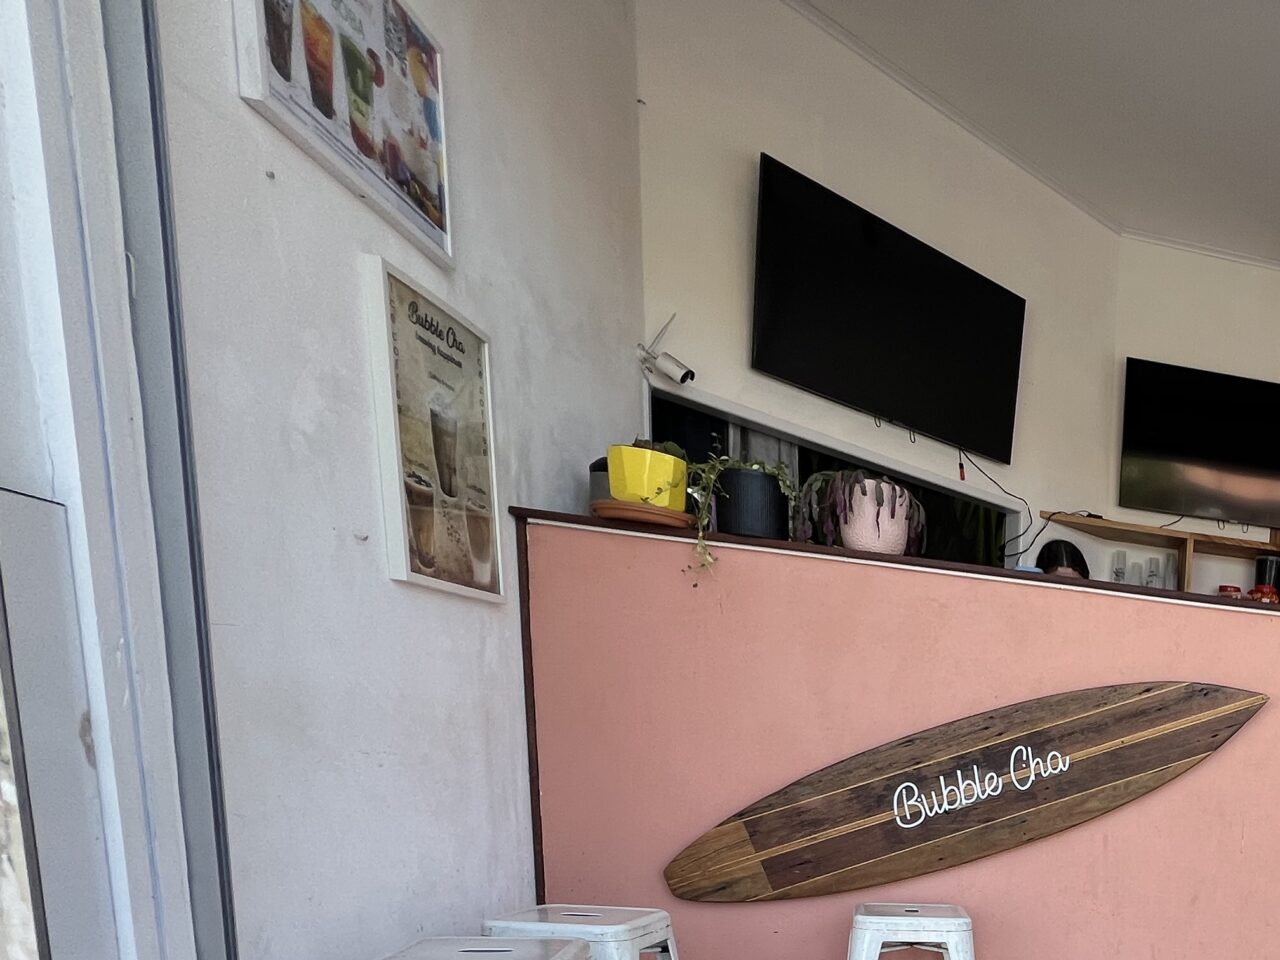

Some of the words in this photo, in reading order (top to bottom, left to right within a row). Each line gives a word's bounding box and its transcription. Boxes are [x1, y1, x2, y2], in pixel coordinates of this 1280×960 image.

[408, 301, 444, 341] Bubble
[446, 326, 465, 354] Cha
[893, 764, 1003, 829] Bubble
[1009, 745, 1070, 791] Cha
